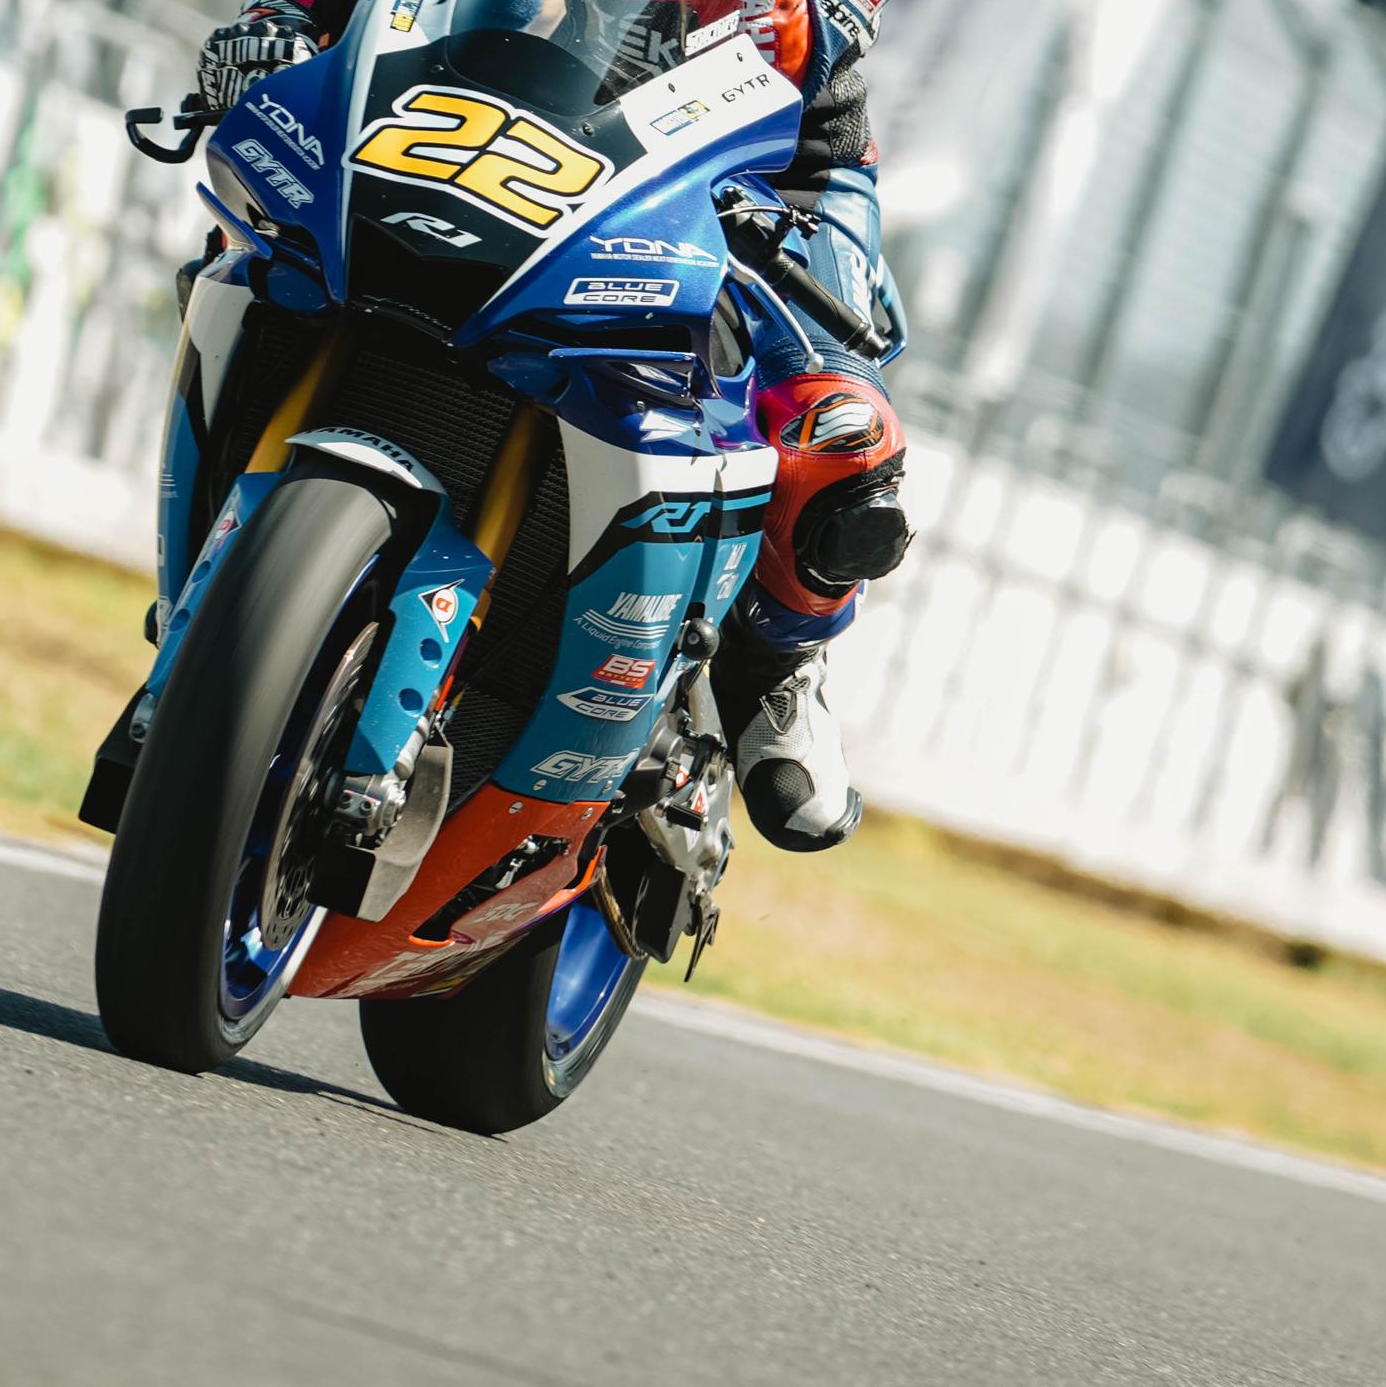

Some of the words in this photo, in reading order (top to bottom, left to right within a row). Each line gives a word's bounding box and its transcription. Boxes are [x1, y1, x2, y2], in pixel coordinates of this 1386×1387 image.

[721, 73, 771, 103] GYTR
[260, 93, 325, 165] YDNA
[232, 139, 315, 209] GYTR
[347, 87, 610, 233] 22
[380, 211, 483, 248] R1
[589, 235, 718, 261] YDNA
[583, 294, 657, 303] CORE
[587, 281, 664, 291] BLUE
[310, 426, 414, 472] AMAHA
[607, 592, 683, 624] YAMALUBE
[581, 620, 609, 641] Liquid
[610, 655, 652, 674] BS
[574, 703, 631, 719] CORE
[591, 694, 644, 707] BLUE
